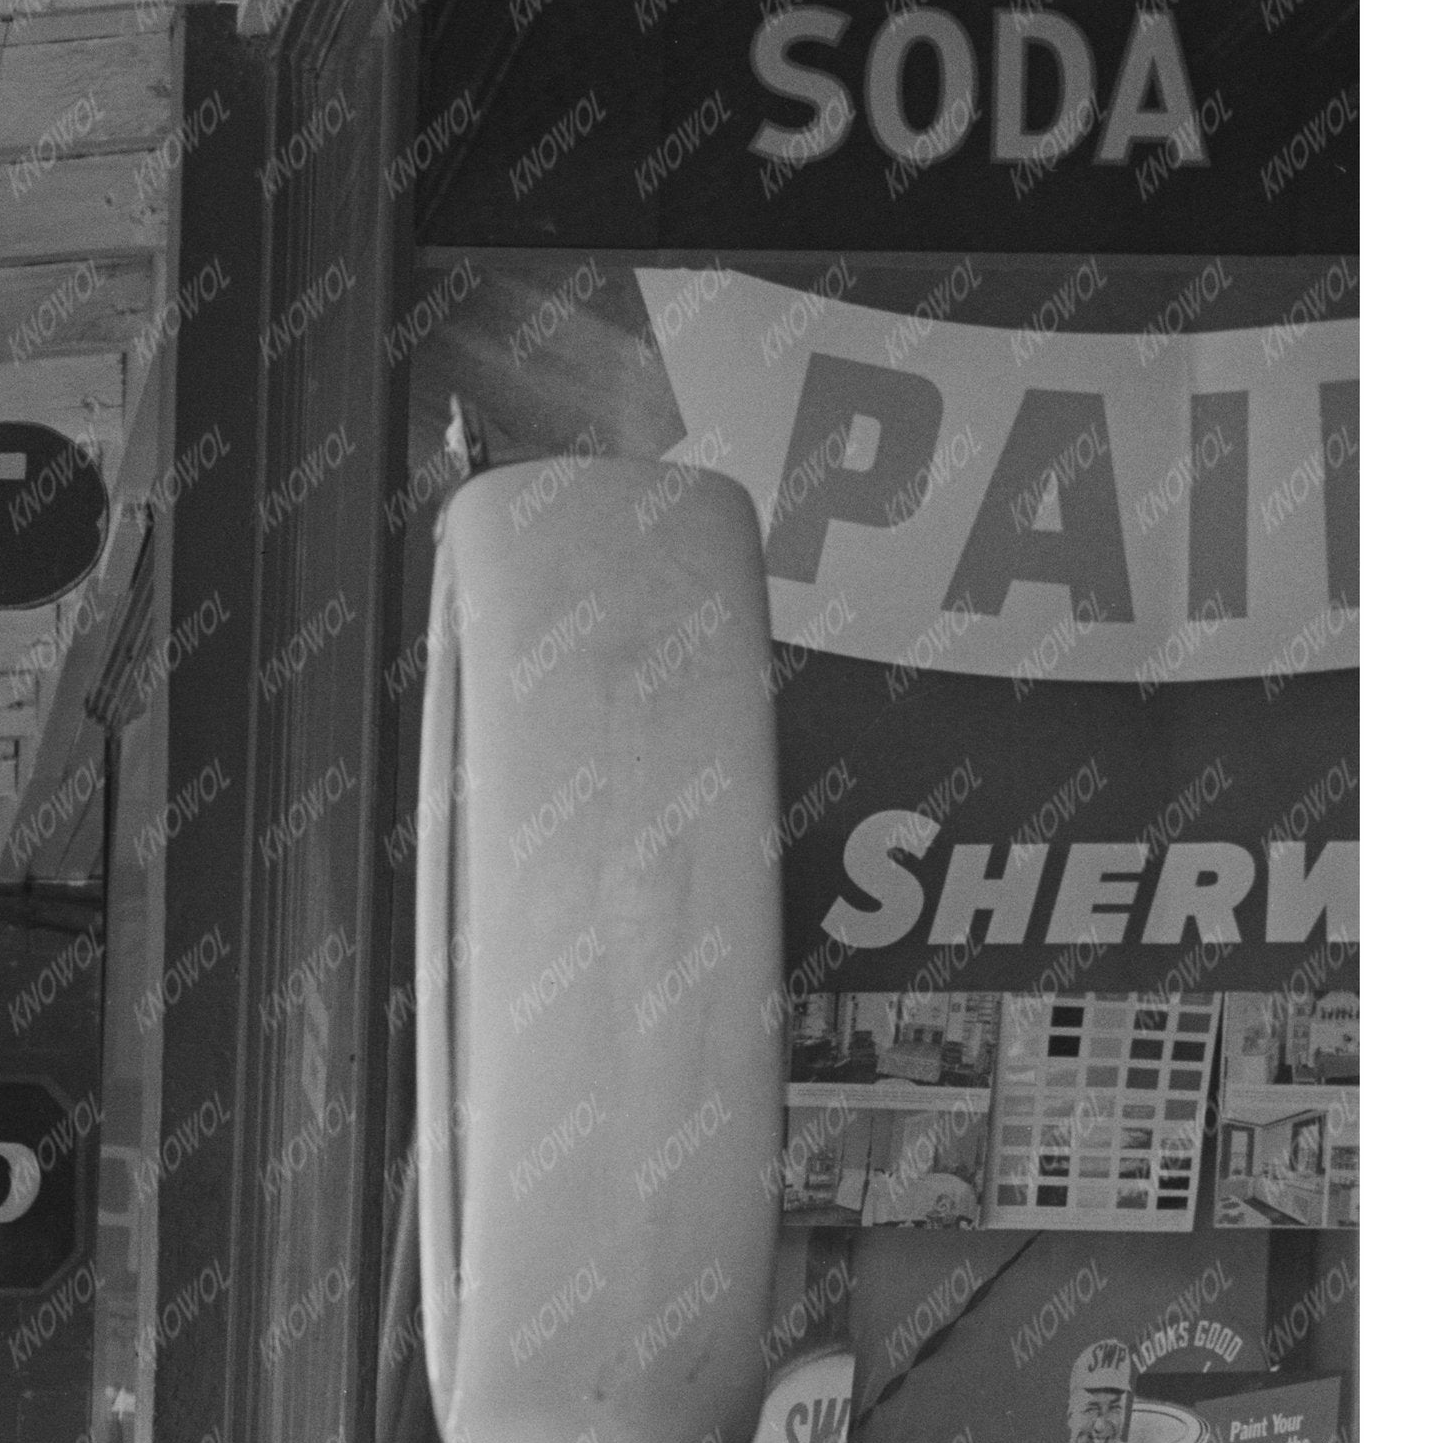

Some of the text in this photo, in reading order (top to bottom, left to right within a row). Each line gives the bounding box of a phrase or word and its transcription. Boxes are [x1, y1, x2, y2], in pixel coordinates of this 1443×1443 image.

[746, 3, 1211, 167] SODA
[763, 350, 1361, 625] PAI
[1132, 1320, 1244, 1374] LOOKS GOOD
[1229, 1412, 1304, 1443] Paint Your
